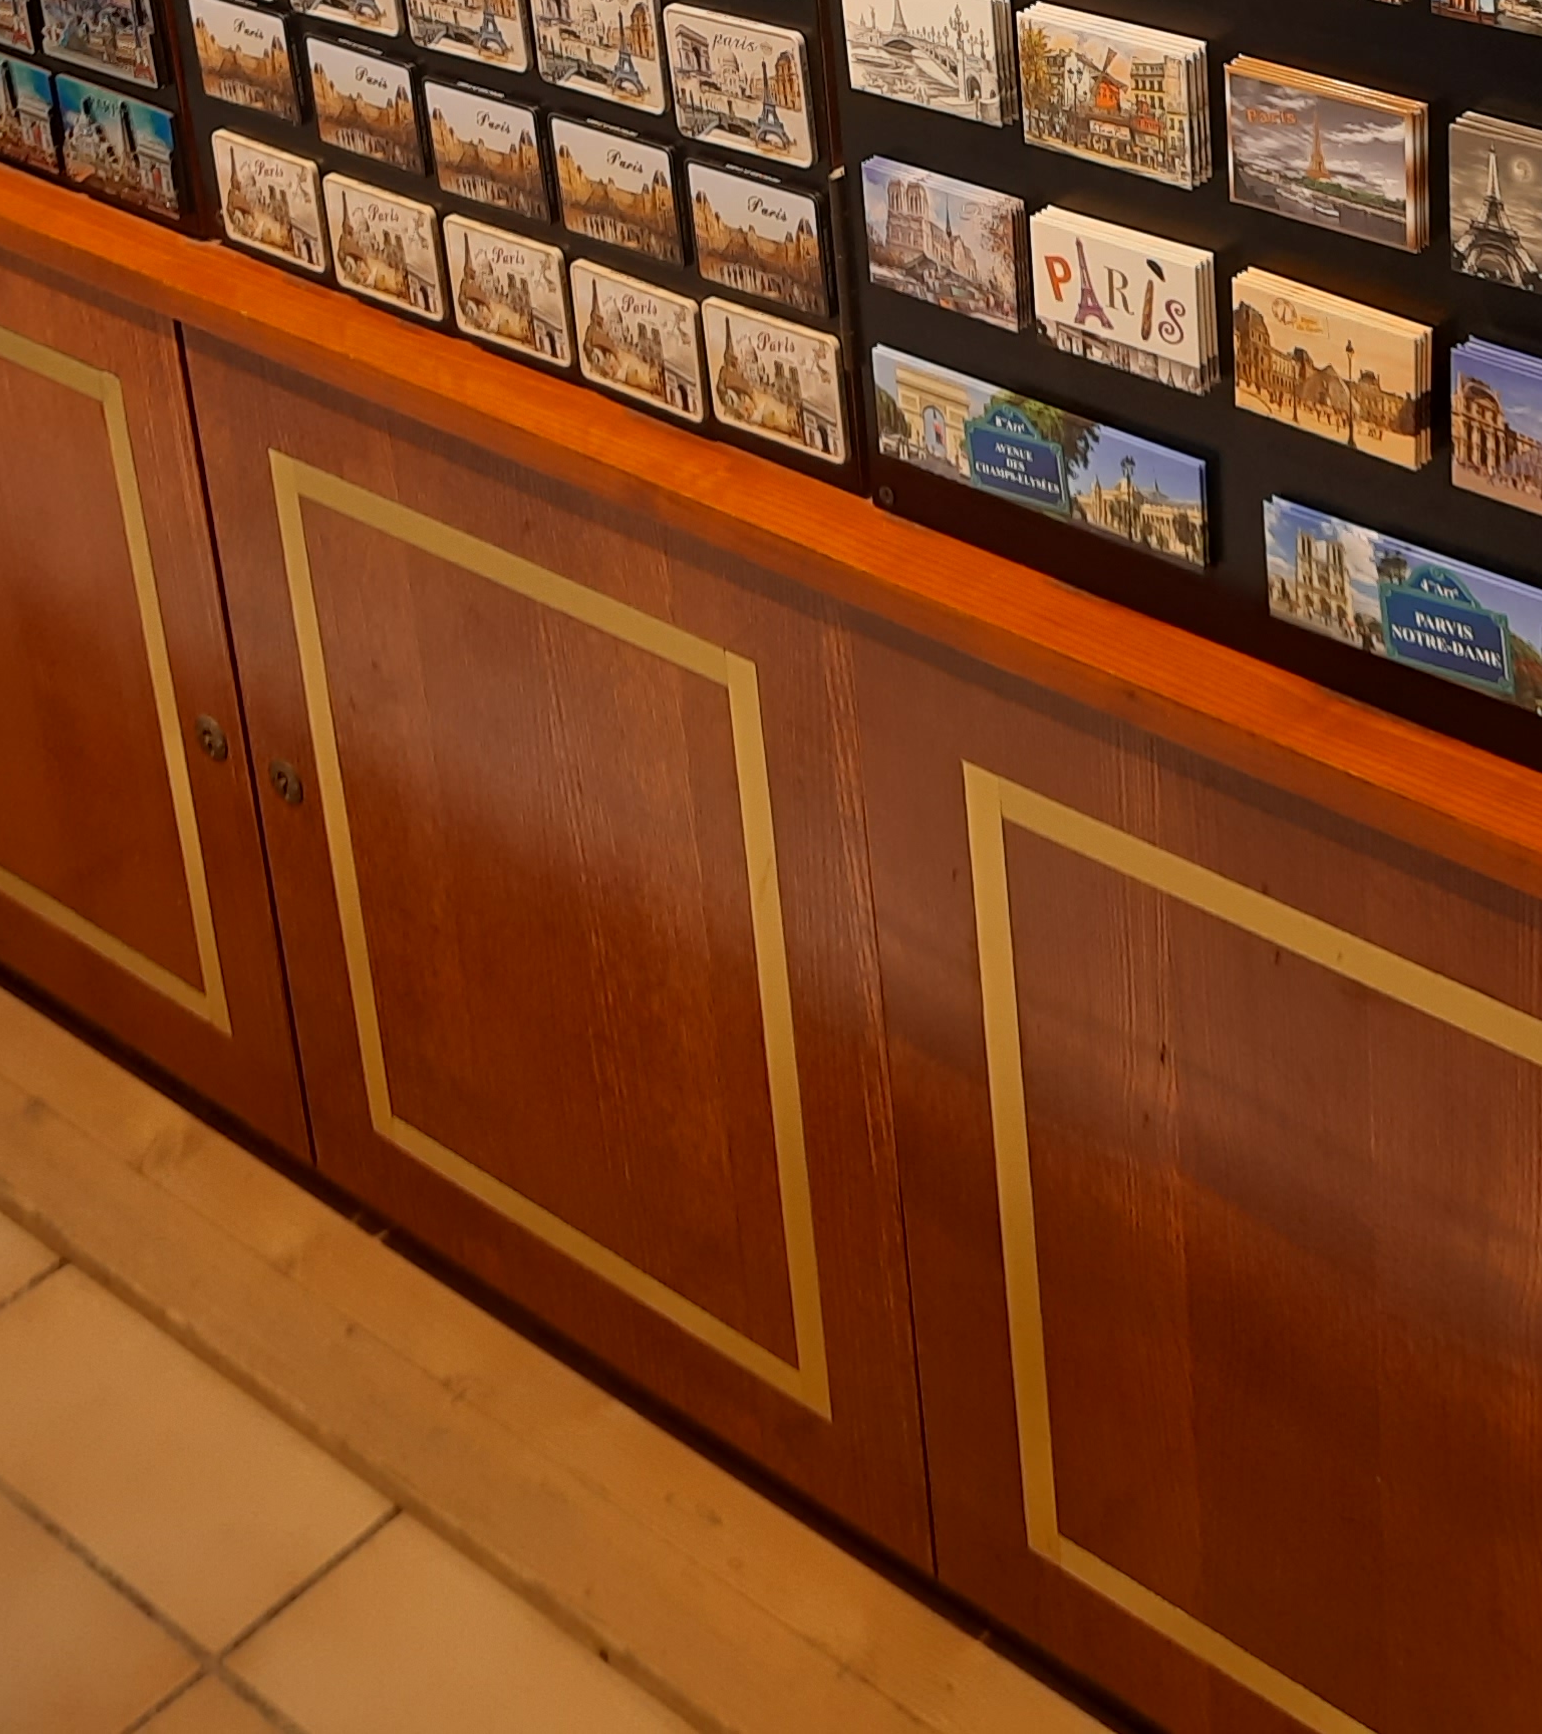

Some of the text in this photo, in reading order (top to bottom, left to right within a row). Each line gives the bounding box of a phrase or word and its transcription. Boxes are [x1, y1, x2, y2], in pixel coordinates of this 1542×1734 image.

[233, 18, 264, 41] Paris
[712, 32, 757, 54] paris
[355, 66, 388, 90] Paris
[476, 111, 511, 134] Paris
[1246, 107, 1297, 125] Paris
[254, 160, 284, 178] Paris
[606, 148, 644, 174] Paris
[367, 203, 400, 223] Paris
[747, 195, 788, 222] Paris
[491, 245, 526, 266] Paris
[621, 293, 658, 316] Paris
[756, 330, 795, 354] Paris
[995, 442, 1034, 463] AVENUE
[1006, 457, 1026, 472] DES
[1414, 611, 1474, 641] PARVIS
[1391, 623, 1503, 669] NOTRE-DAME
